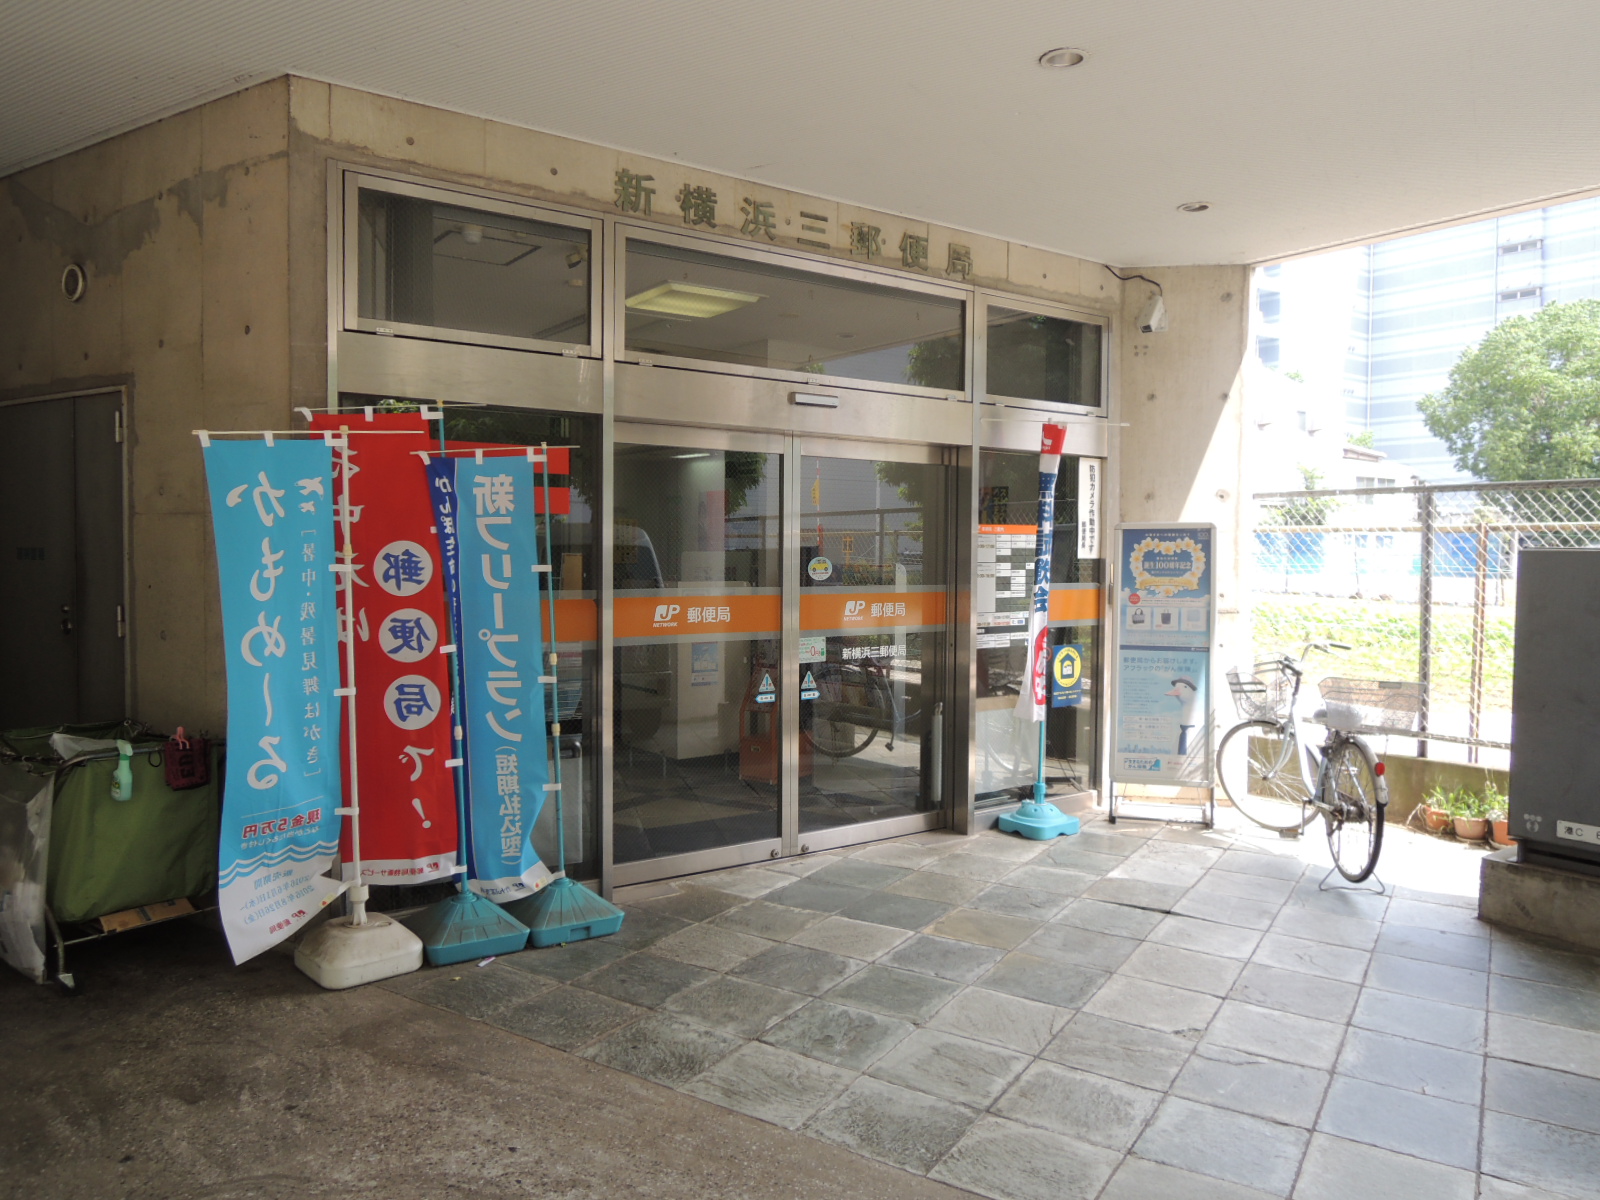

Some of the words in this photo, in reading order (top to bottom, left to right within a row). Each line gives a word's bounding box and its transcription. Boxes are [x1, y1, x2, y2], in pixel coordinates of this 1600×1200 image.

[615, 168, 973, 280] 新横浜三郵便局
[687, 606, 731, 623] 郵便局
[870, 602, 906, 618] 郵便局
[842, 645, 907, 661] 新横浜三郵便局
